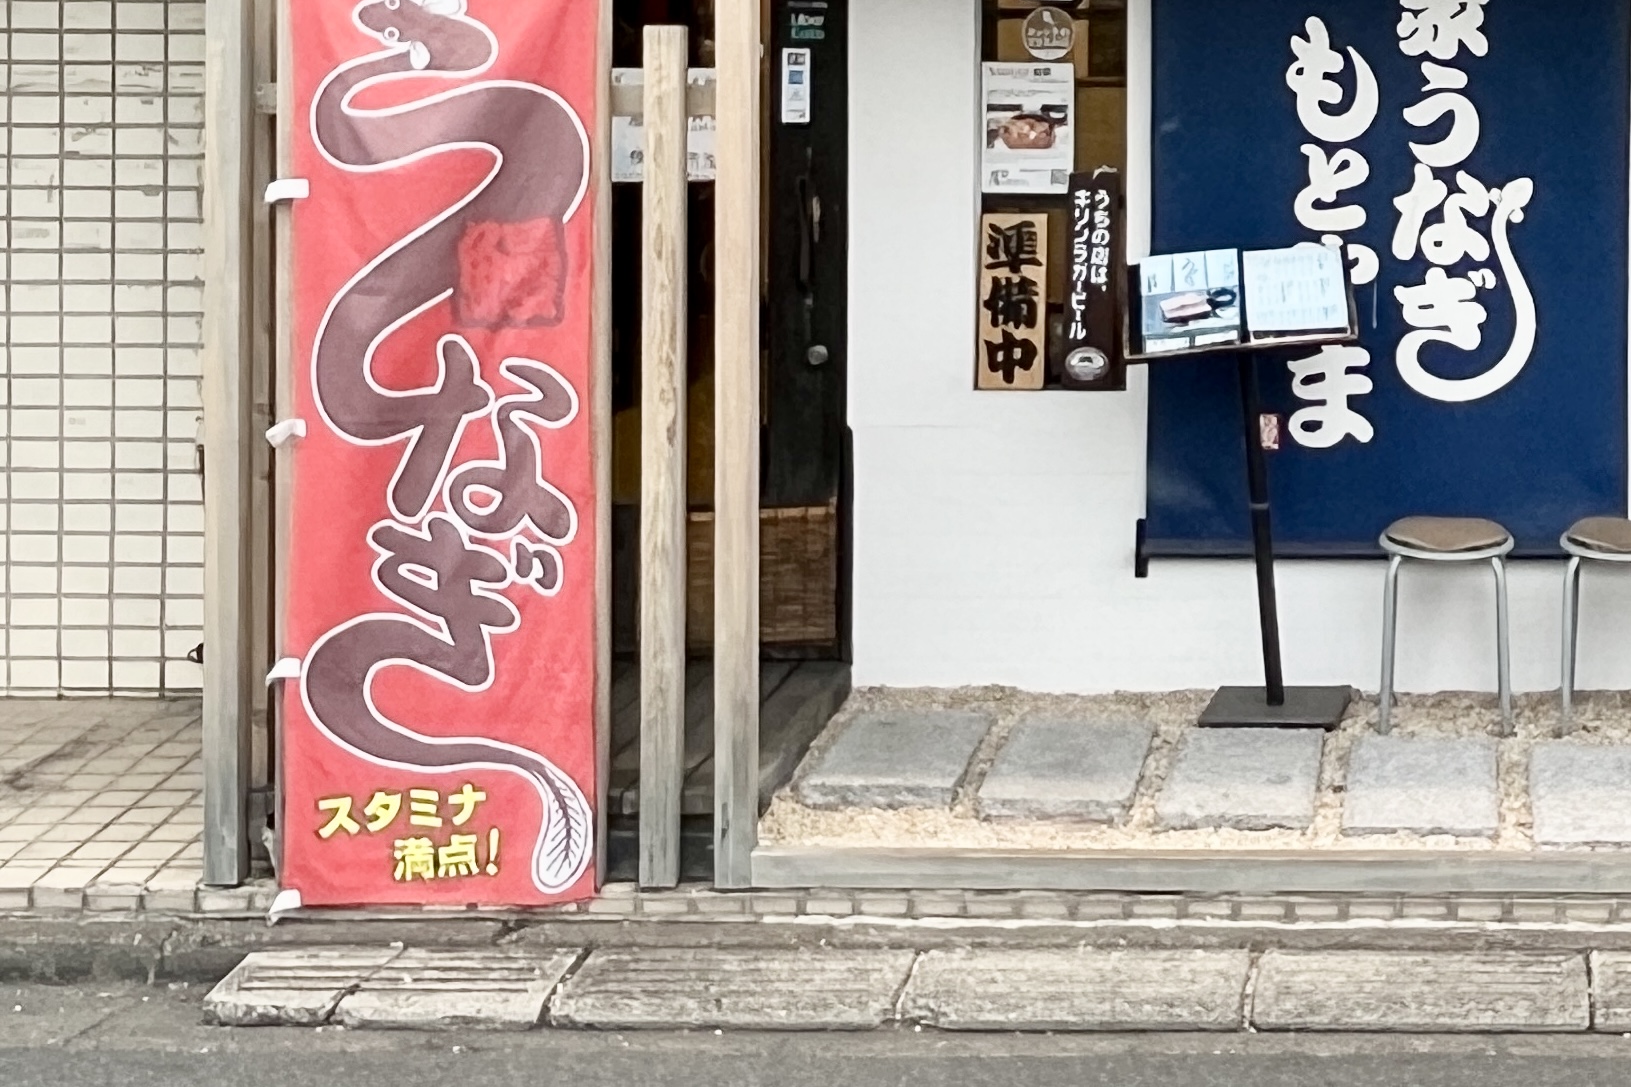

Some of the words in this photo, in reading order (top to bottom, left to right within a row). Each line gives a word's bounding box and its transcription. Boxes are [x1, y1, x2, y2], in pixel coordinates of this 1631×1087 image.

[984, 220, 1043, 385] 準備中
[317, 784, 487, 839] スタミナ
